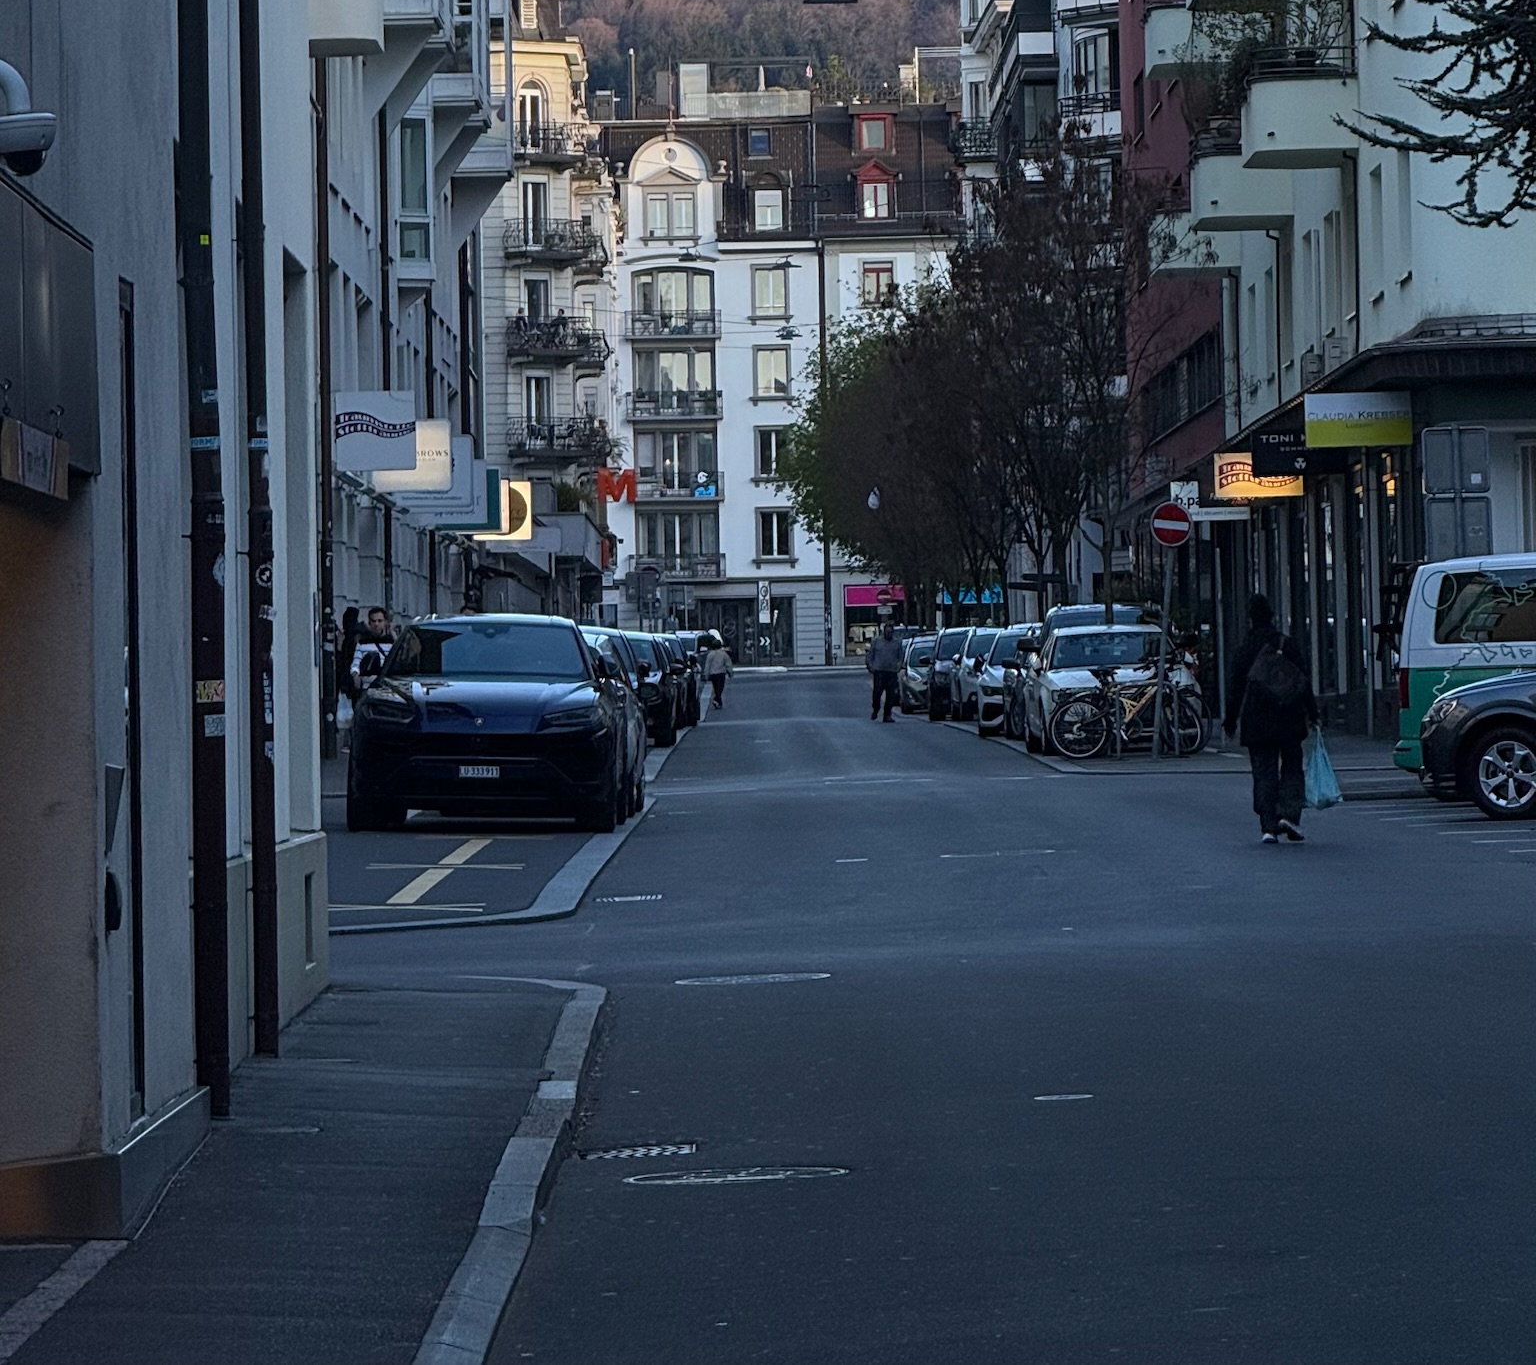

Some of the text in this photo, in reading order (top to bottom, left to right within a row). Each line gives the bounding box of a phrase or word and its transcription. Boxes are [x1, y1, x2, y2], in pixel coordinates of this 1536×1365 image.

[1307, 411, 1354, 421] CLAUDIA
[1260, 434, 1294, 444] TONI
[597, 467, 636, 504] M
